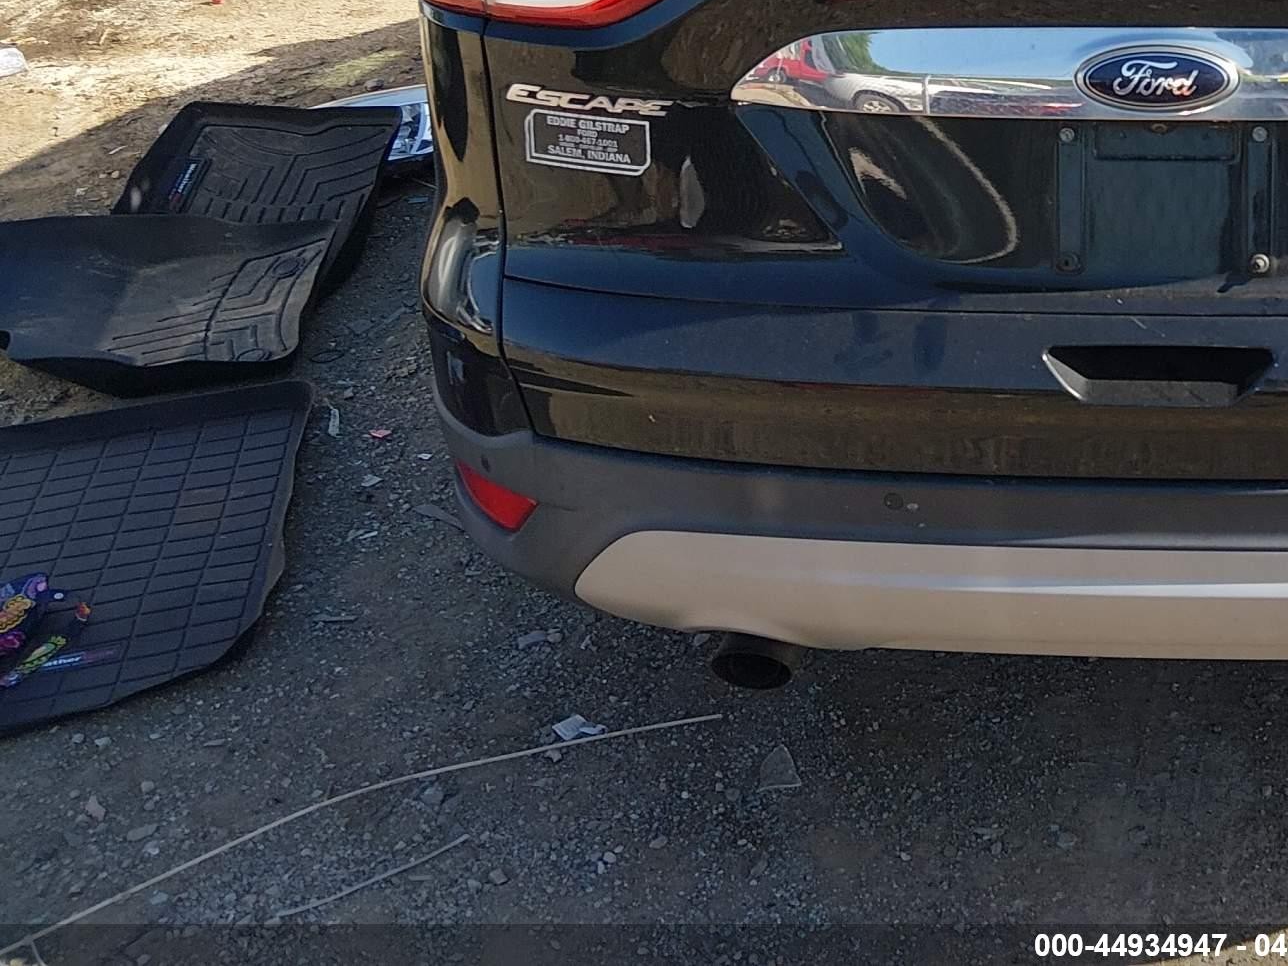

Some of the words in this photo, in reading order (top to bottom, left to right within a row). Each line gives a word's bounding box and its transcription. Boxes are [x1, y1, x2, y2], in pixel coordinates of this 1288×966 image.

[1112, 59, 1199, 96] Ford
[506, 83, 674, 117] ESCAPE
[546, 115, 577, 128] EDDIE
[578, 119, 630, 134] GILSTRAP
[587, 150, 631, 164] INDIANA
